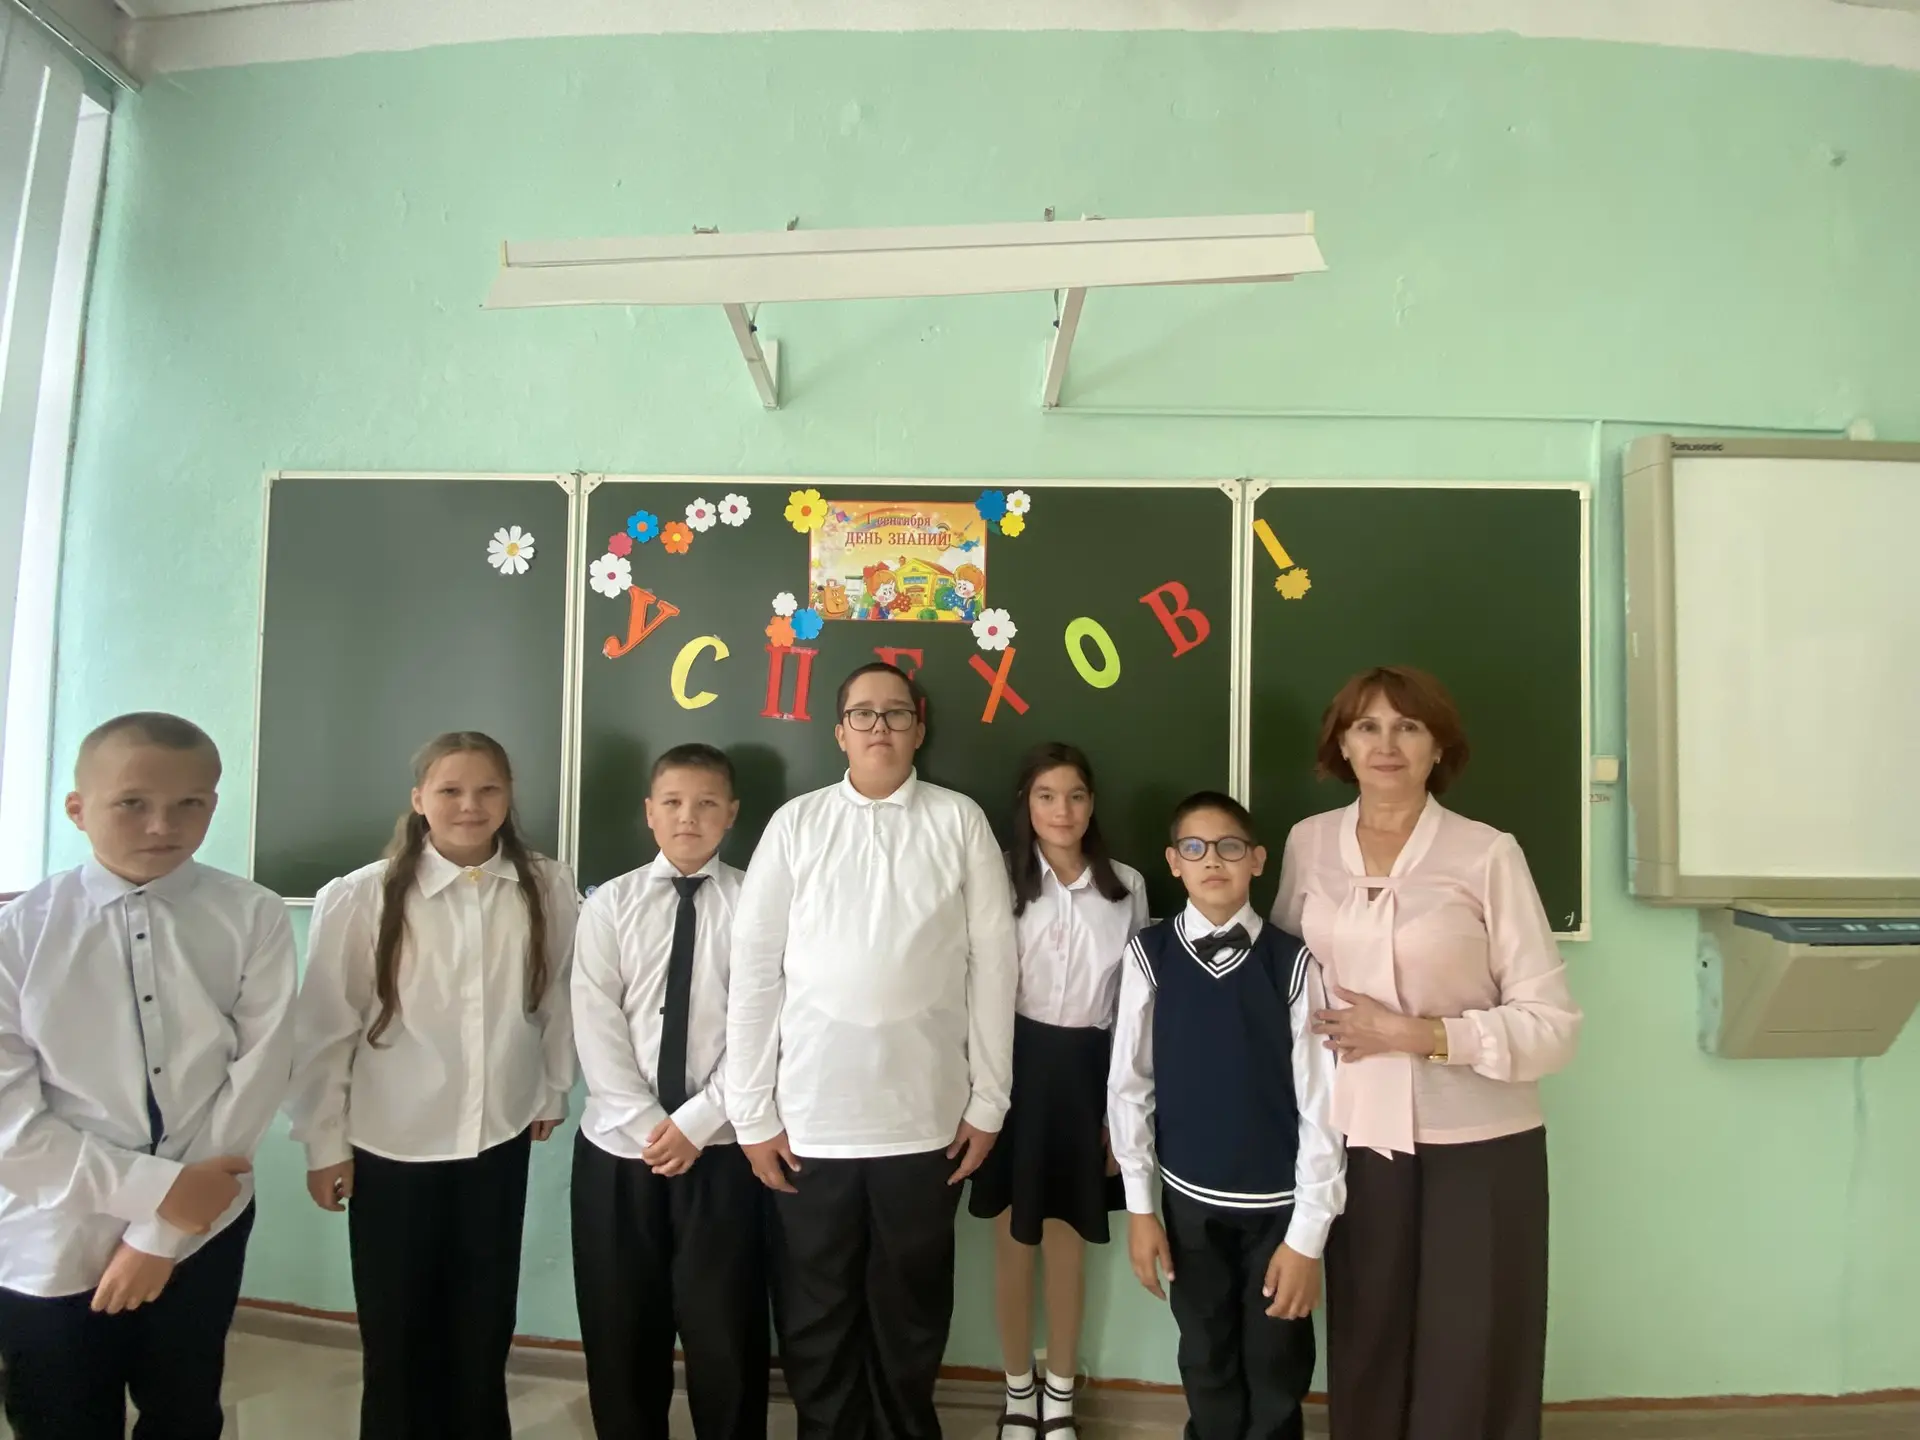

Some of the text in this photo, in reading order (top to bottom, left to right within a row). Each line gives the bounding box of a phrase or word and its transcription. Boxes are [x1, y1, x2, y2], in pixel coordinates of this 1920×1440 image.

[865, 511, 931, 528] 1 сентября
[846, 531, 951, 547] ДЕНЬ ЗНАНИЙ!
